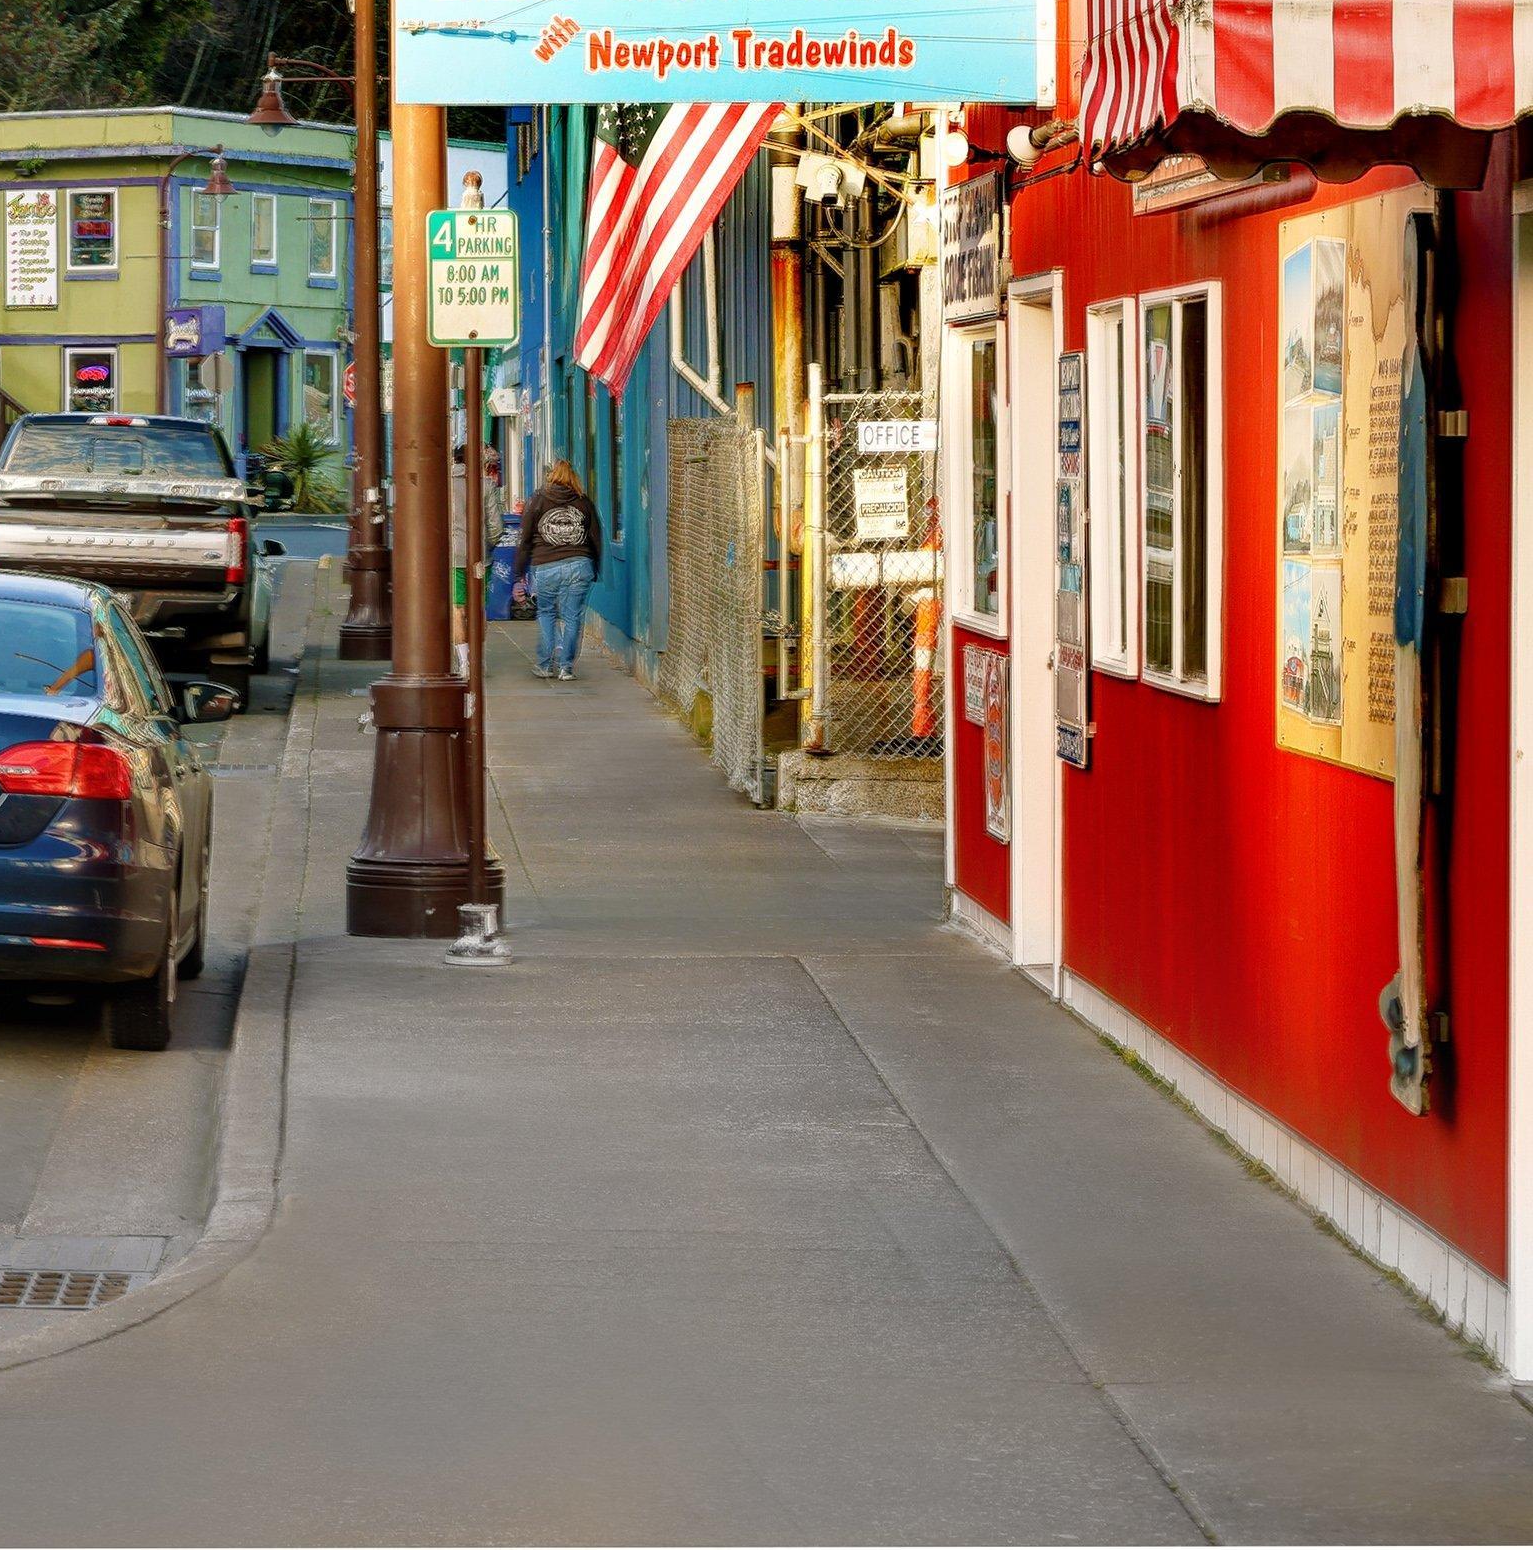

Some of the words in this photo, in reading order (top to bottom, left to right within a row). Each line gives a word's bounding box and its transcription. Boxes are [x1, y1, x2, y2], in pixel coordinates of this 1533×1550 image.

[535, 15, 581, 62] with
[588, 31, 720, 79] Newport
[732, 28, 916, 70] Tradewinds
[475, 216, 497, 233] HR
[432, 219, 453, 252] 4
[457, 236, 512, 255] PARKING
[447, 264, 476, 283] 8:00
[481, 264, 500, 283] AM
[438, 287, 454, 305] TO
[458, 287, 486, 305] 5:00
[491, 287, 509, 305] PM
[863, 425, 920, 446] OFFICE
[859, 468, 904, 479] CAUTION
